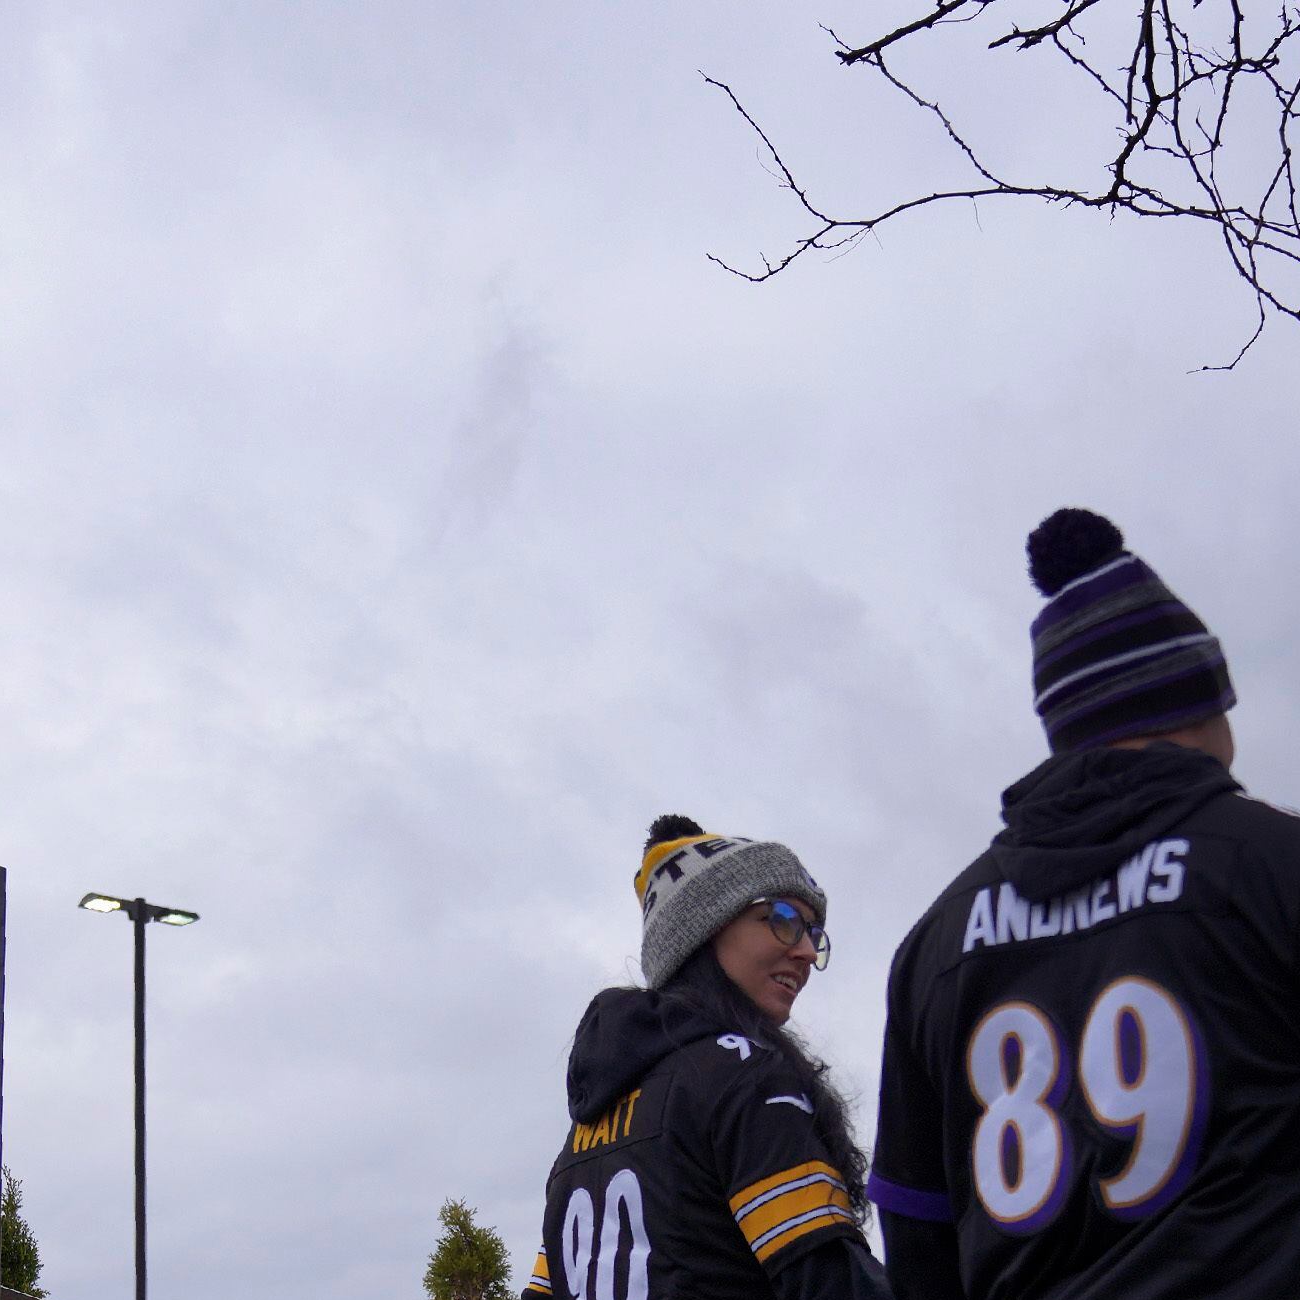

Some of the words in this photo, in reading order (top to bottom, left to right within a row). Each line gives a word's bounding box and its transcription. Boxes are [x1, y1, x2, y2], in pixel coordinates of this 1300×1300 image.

[962, 838, 1190, 954] ANDREWS
[572, 1088, 642, 1154] WATT
[966, 975, 1205, 1230] 89
